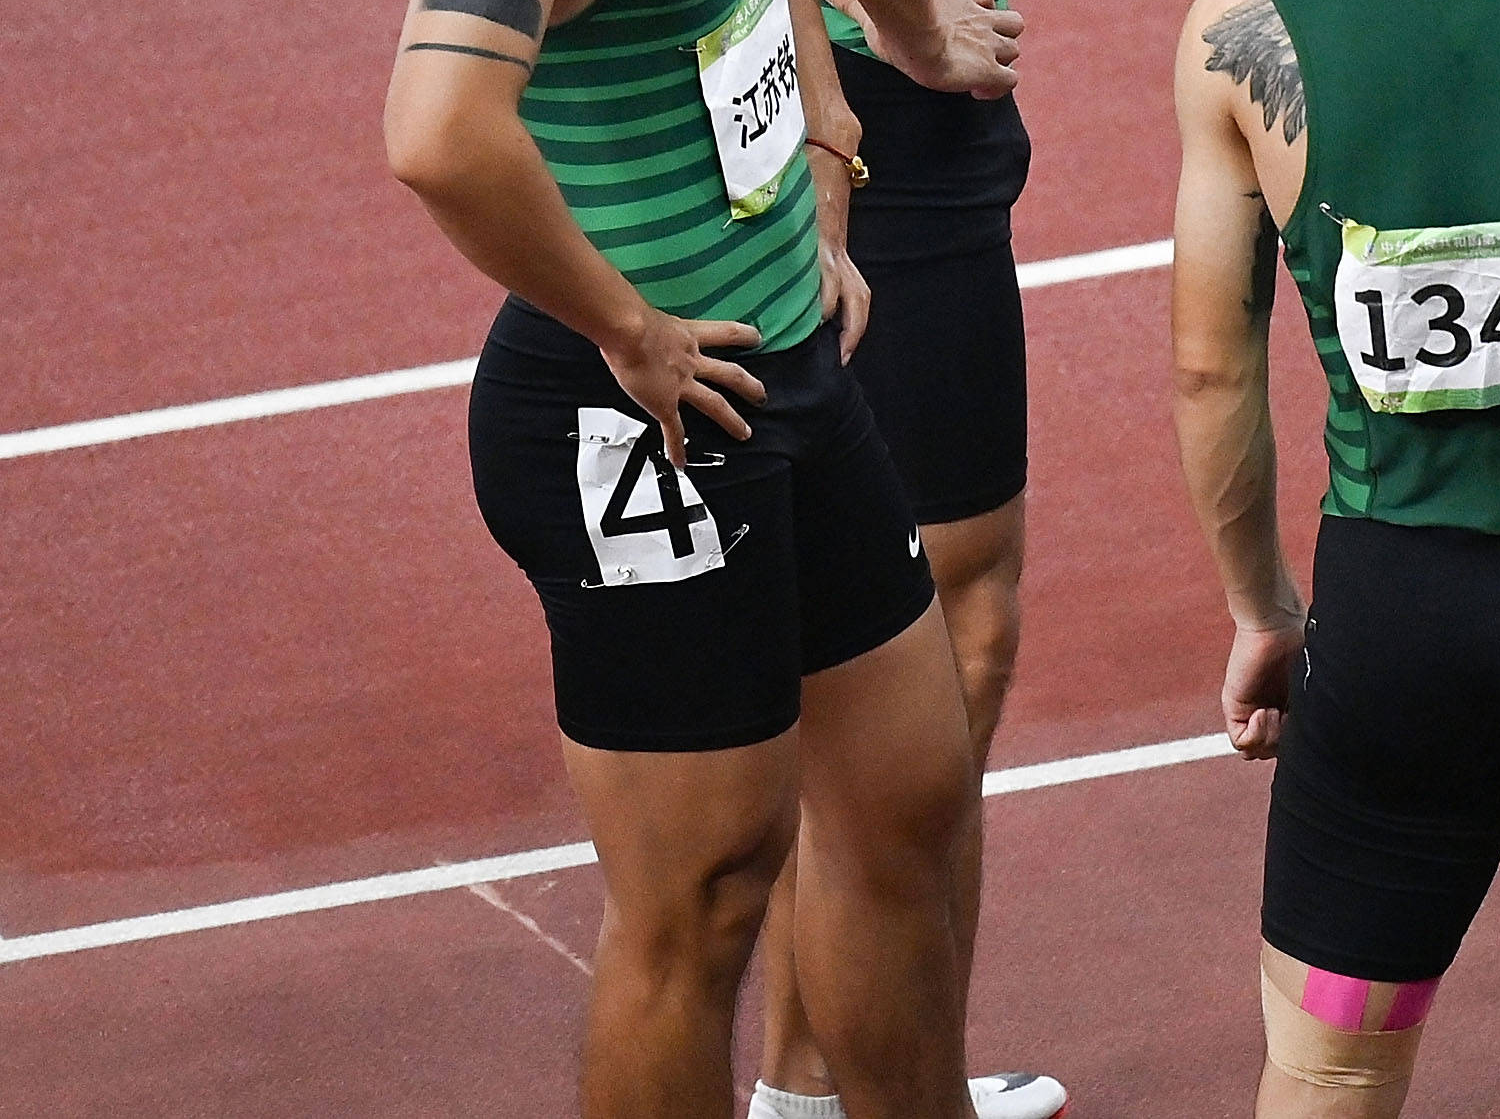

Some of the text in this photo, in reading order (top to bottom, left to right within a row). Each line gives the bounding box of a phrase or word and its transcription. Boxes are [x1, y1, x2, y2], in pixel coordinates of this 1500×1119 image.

[732, 33, 797, 149] 江苏铁
[600, 427, 707, 559] 4
